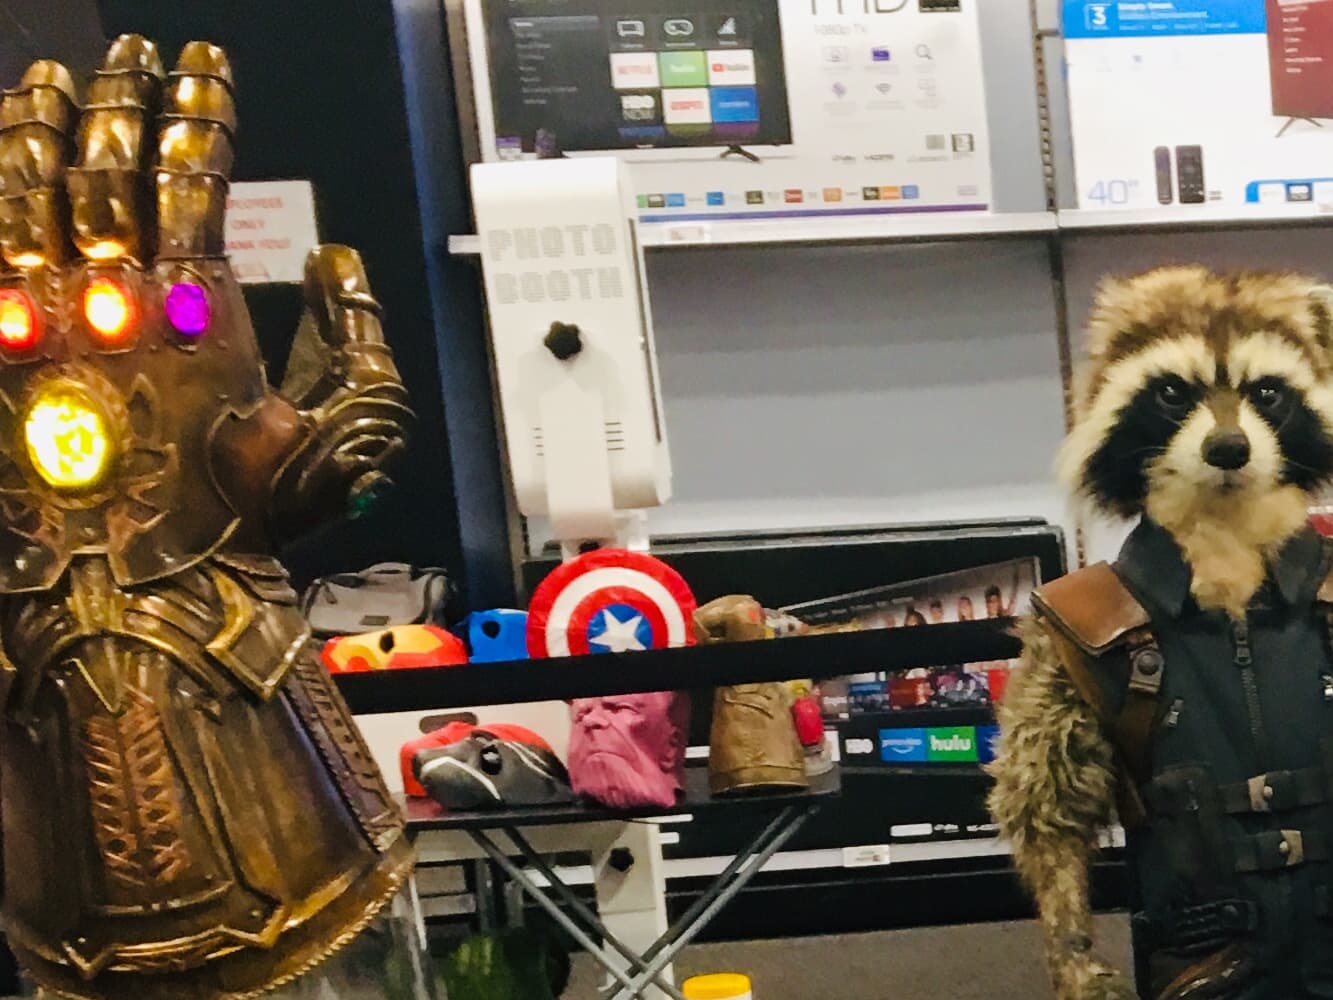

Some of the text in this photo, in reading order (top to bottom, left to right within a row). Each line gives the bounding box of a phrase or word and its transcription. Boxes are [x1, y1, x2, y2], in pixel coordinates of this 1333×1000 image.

[487, 224, 617, 261] PHOTO
[493, 266, 624, 304] BOOTH
[930, 735, 971, 751] hulu
